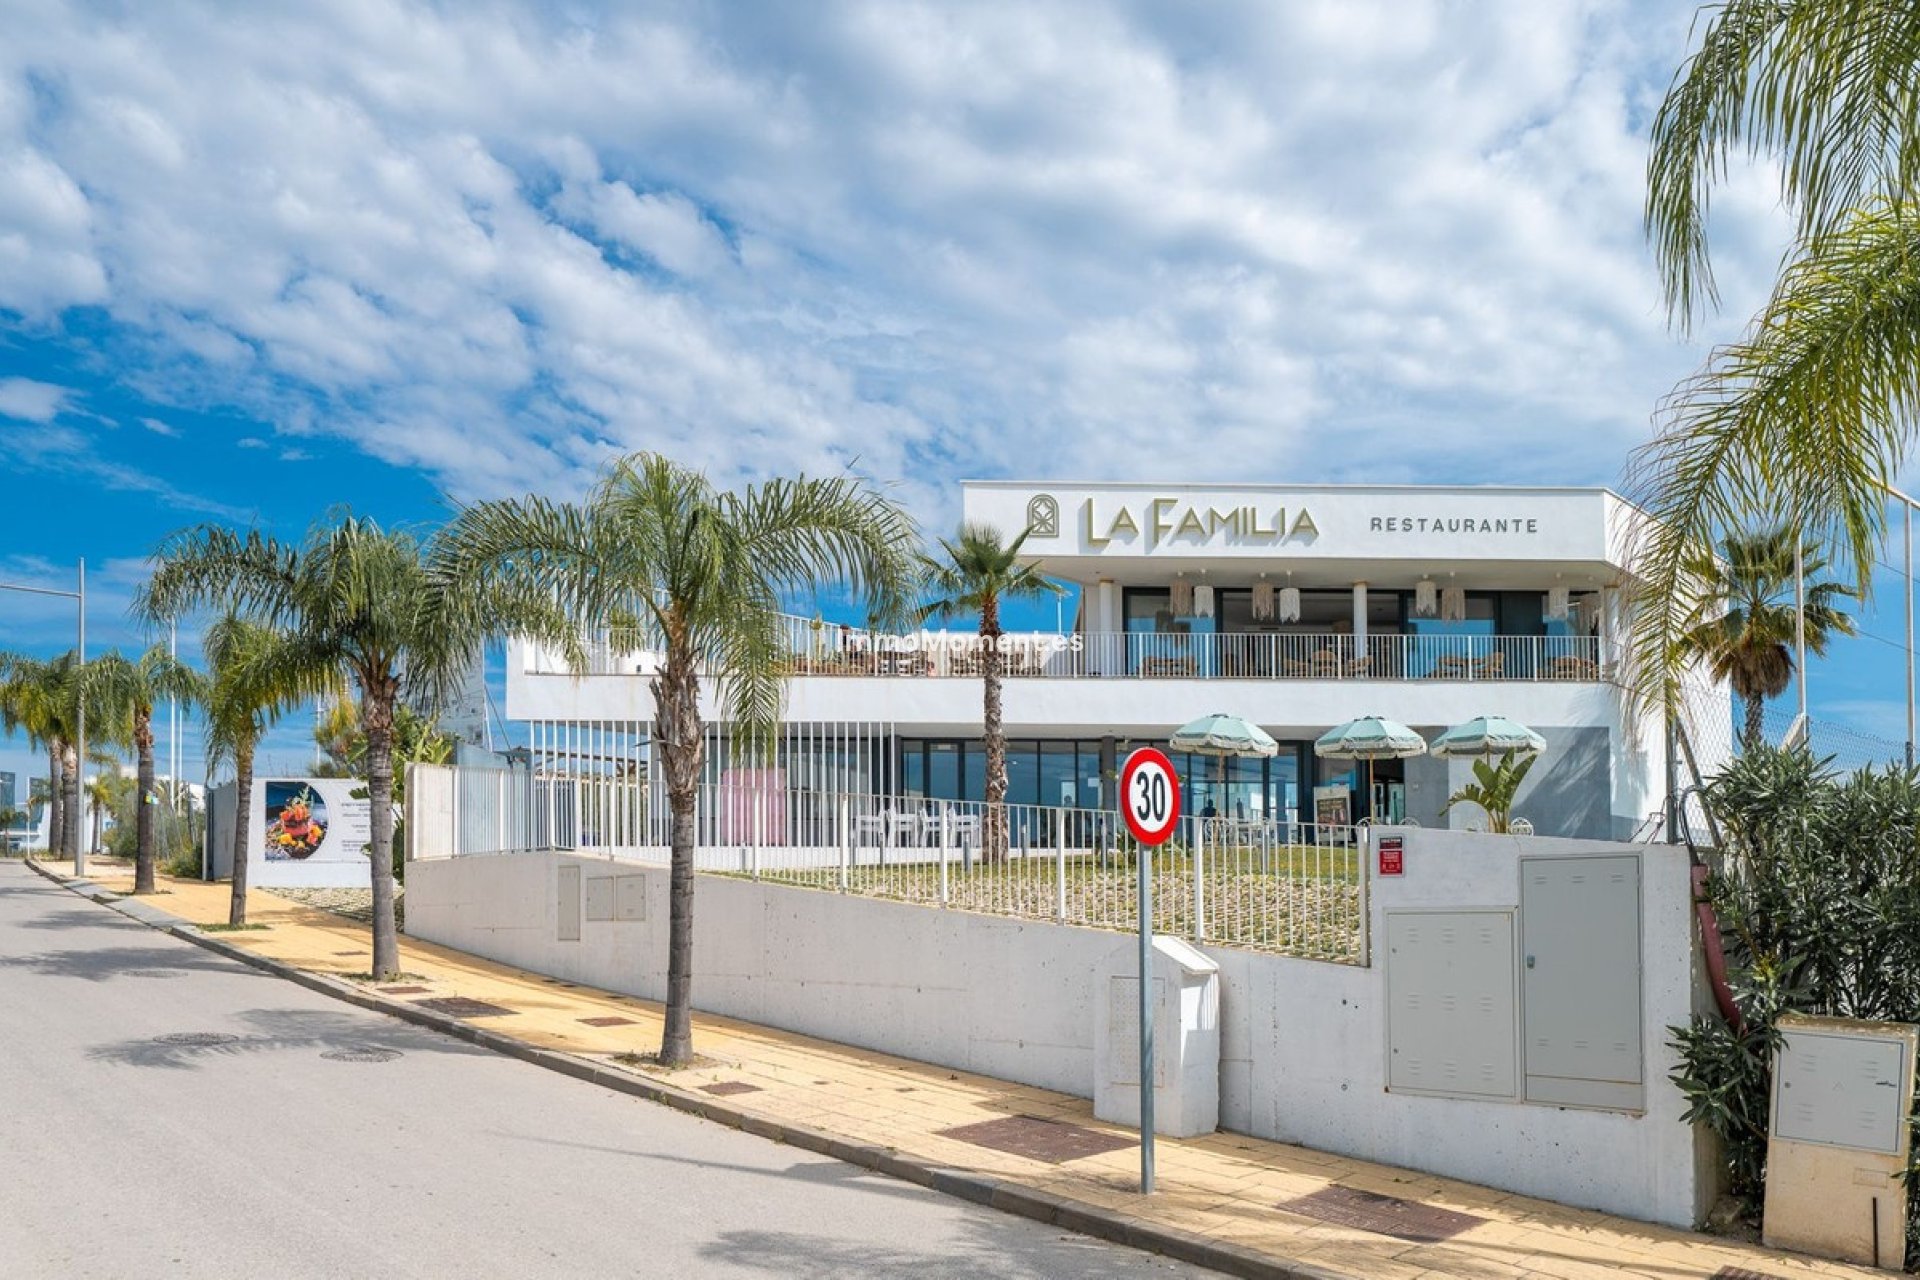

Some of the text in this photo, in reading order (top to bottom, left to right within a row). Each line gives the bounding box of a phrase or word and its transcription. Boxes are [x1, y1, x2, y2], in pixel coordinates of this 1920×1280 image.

[1153, 497, 1320, 546] FAMILIA
[1370, 516, 1538, 533] RESTAURANTE
[1136, 771, 1166, 822] 30
